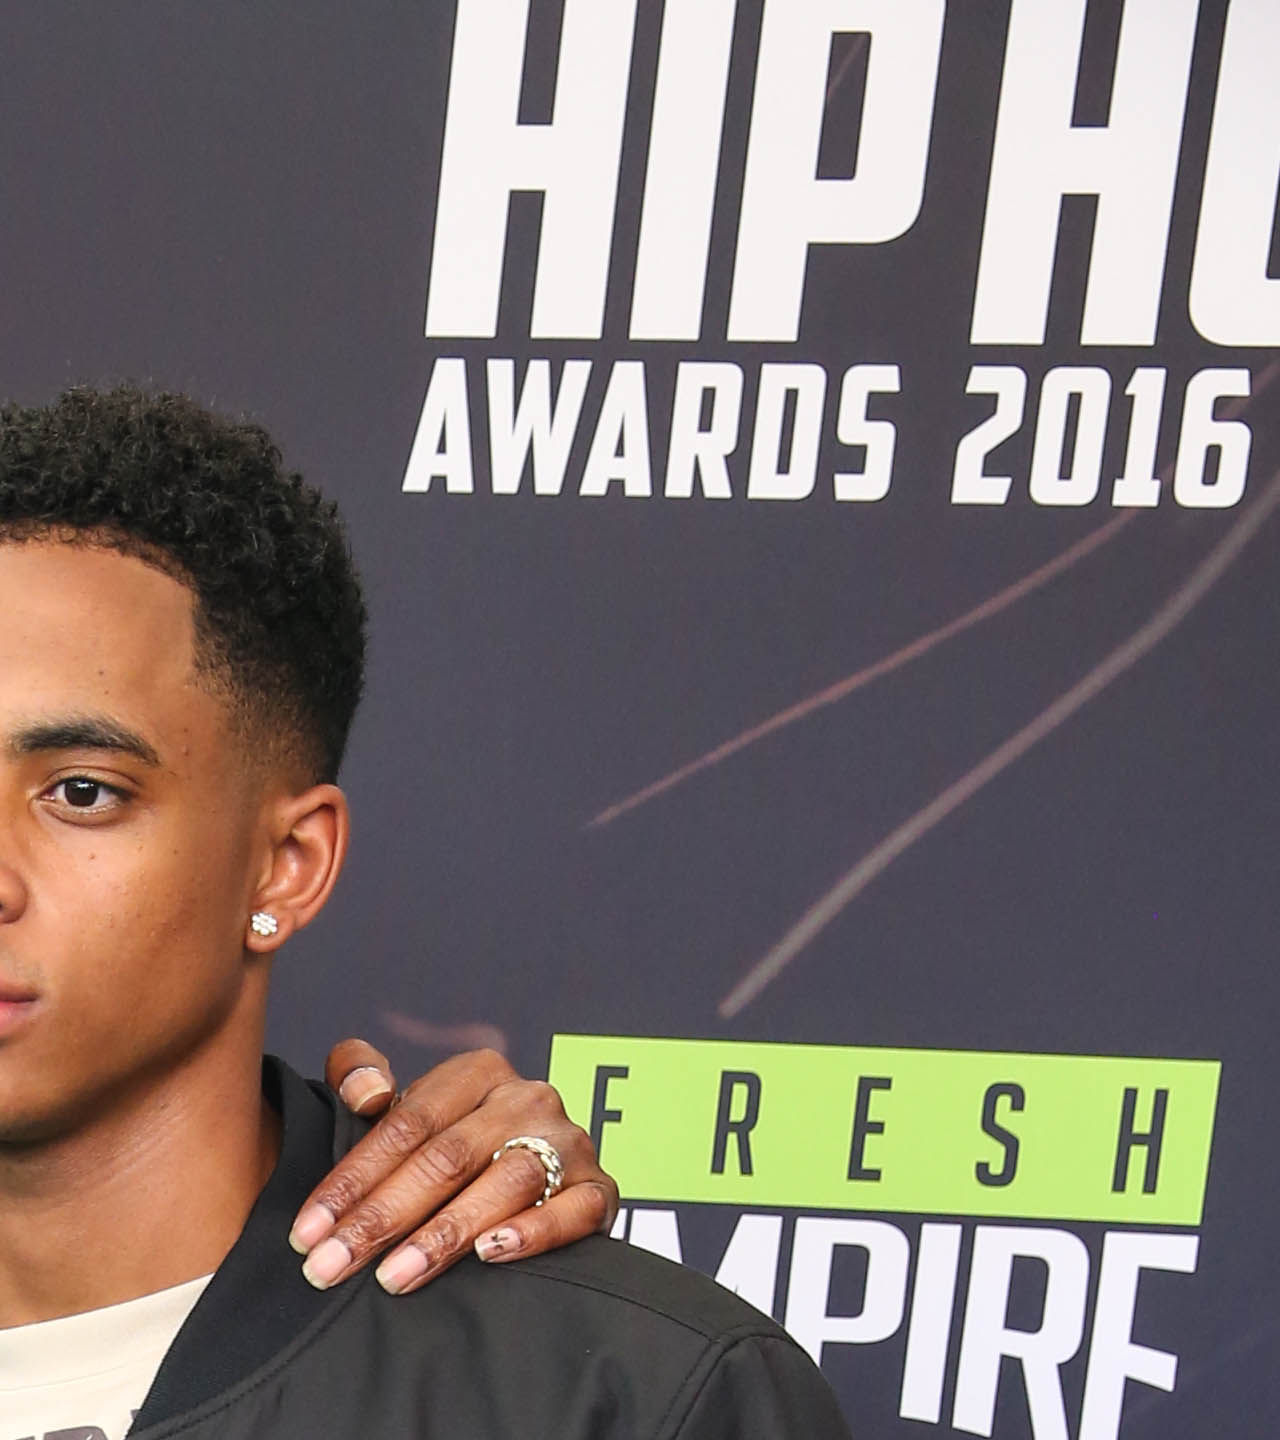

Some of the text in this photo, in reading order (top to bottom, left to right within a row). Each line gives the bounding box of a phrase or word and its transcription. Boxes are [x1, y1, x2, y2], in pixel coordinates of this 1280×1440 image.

[424, 0, 946, 342] HIP
[401, 358, 1253, 509] AWARDS 2016
[588, 1065, 1170, 1196] FRESH
